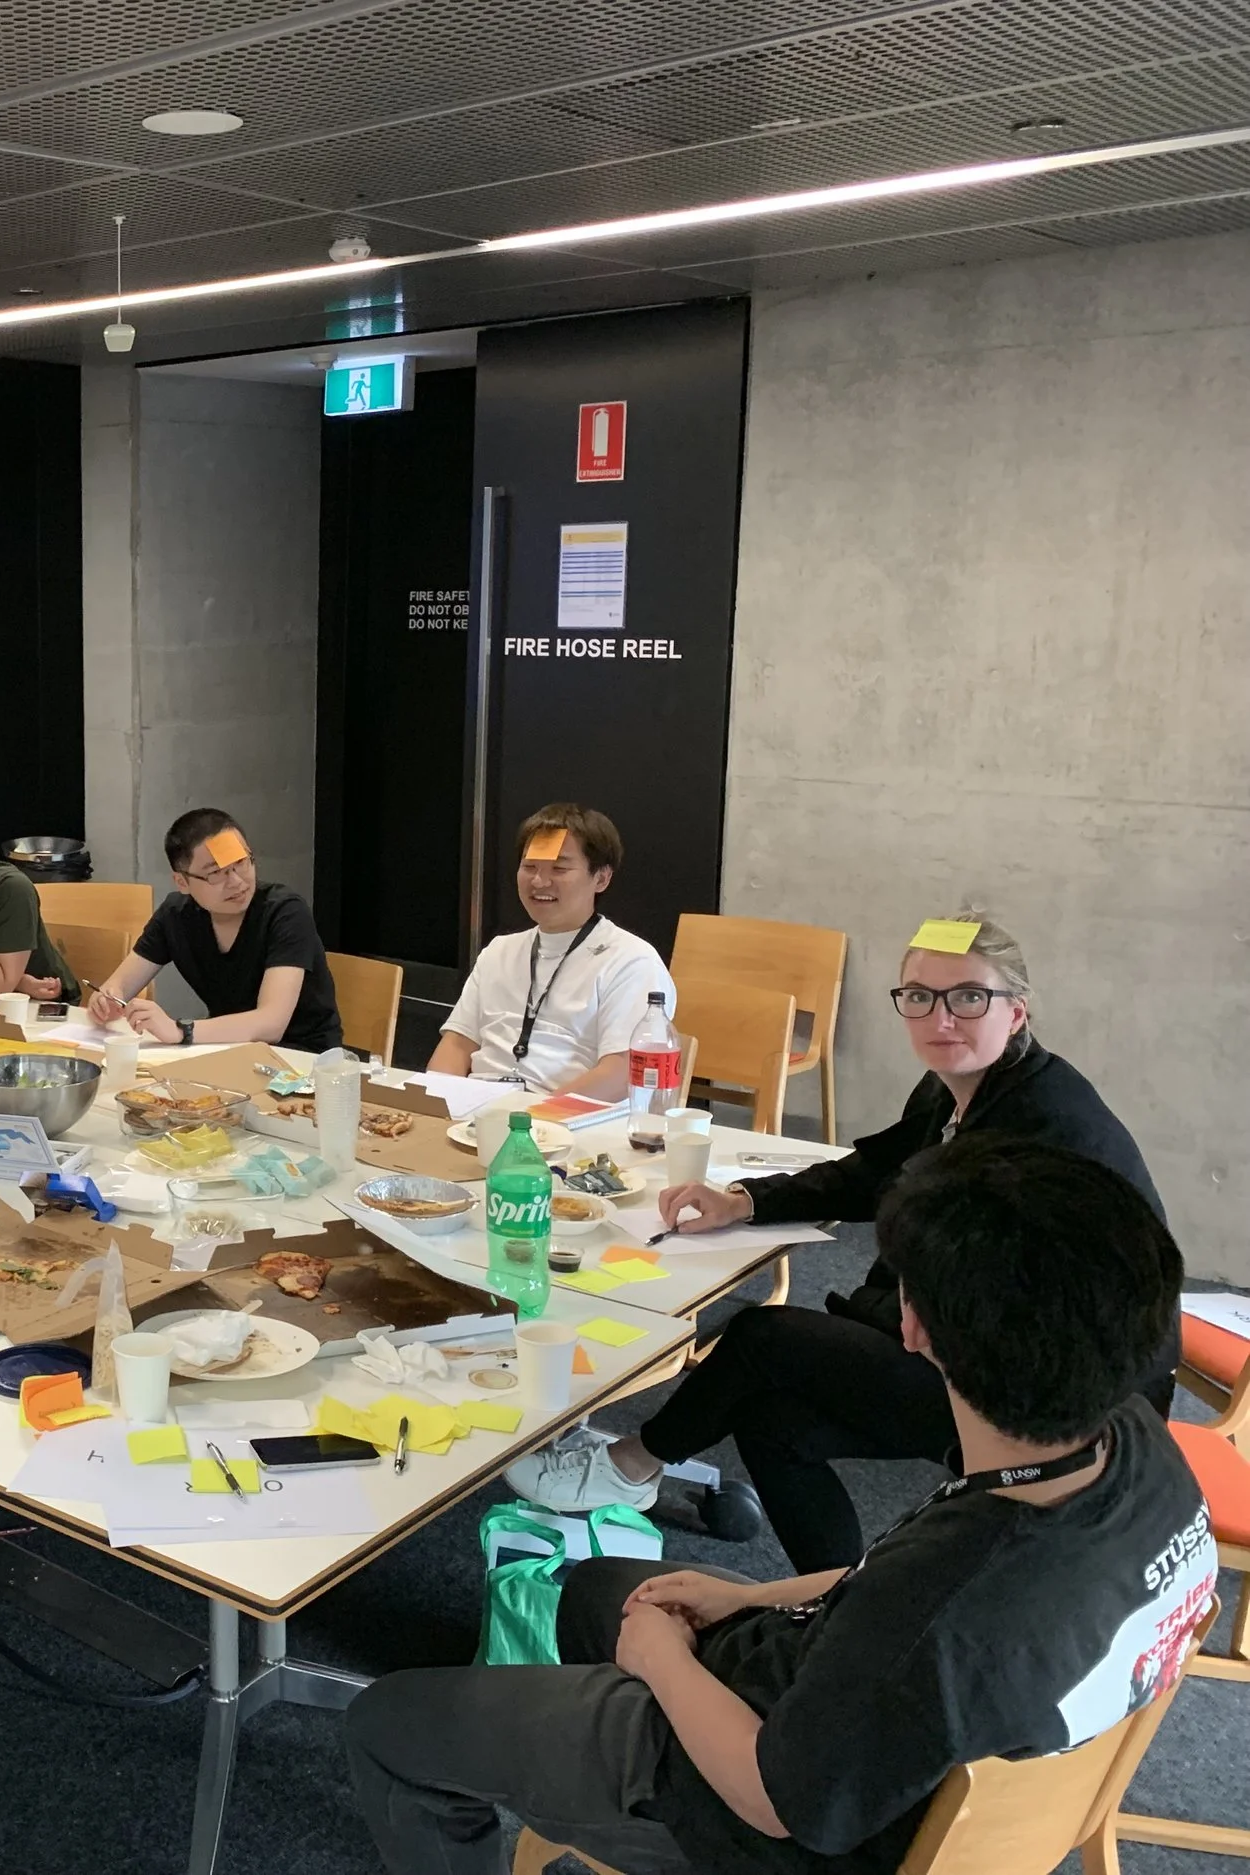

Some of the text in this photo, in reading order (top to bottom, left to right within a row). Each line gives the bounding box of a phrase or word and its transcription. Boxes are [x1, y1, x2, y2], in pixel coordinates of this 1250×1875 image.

[409, 590, 434, 602] FIRE
[409, 604, 470, 616] DO NOT OB
[408, 618, 469, 630] DO NOT KE
[504, 637, 683, 660] FIRE HOSE REEL
[1012, 1467, 1041, 1479] UNSW
